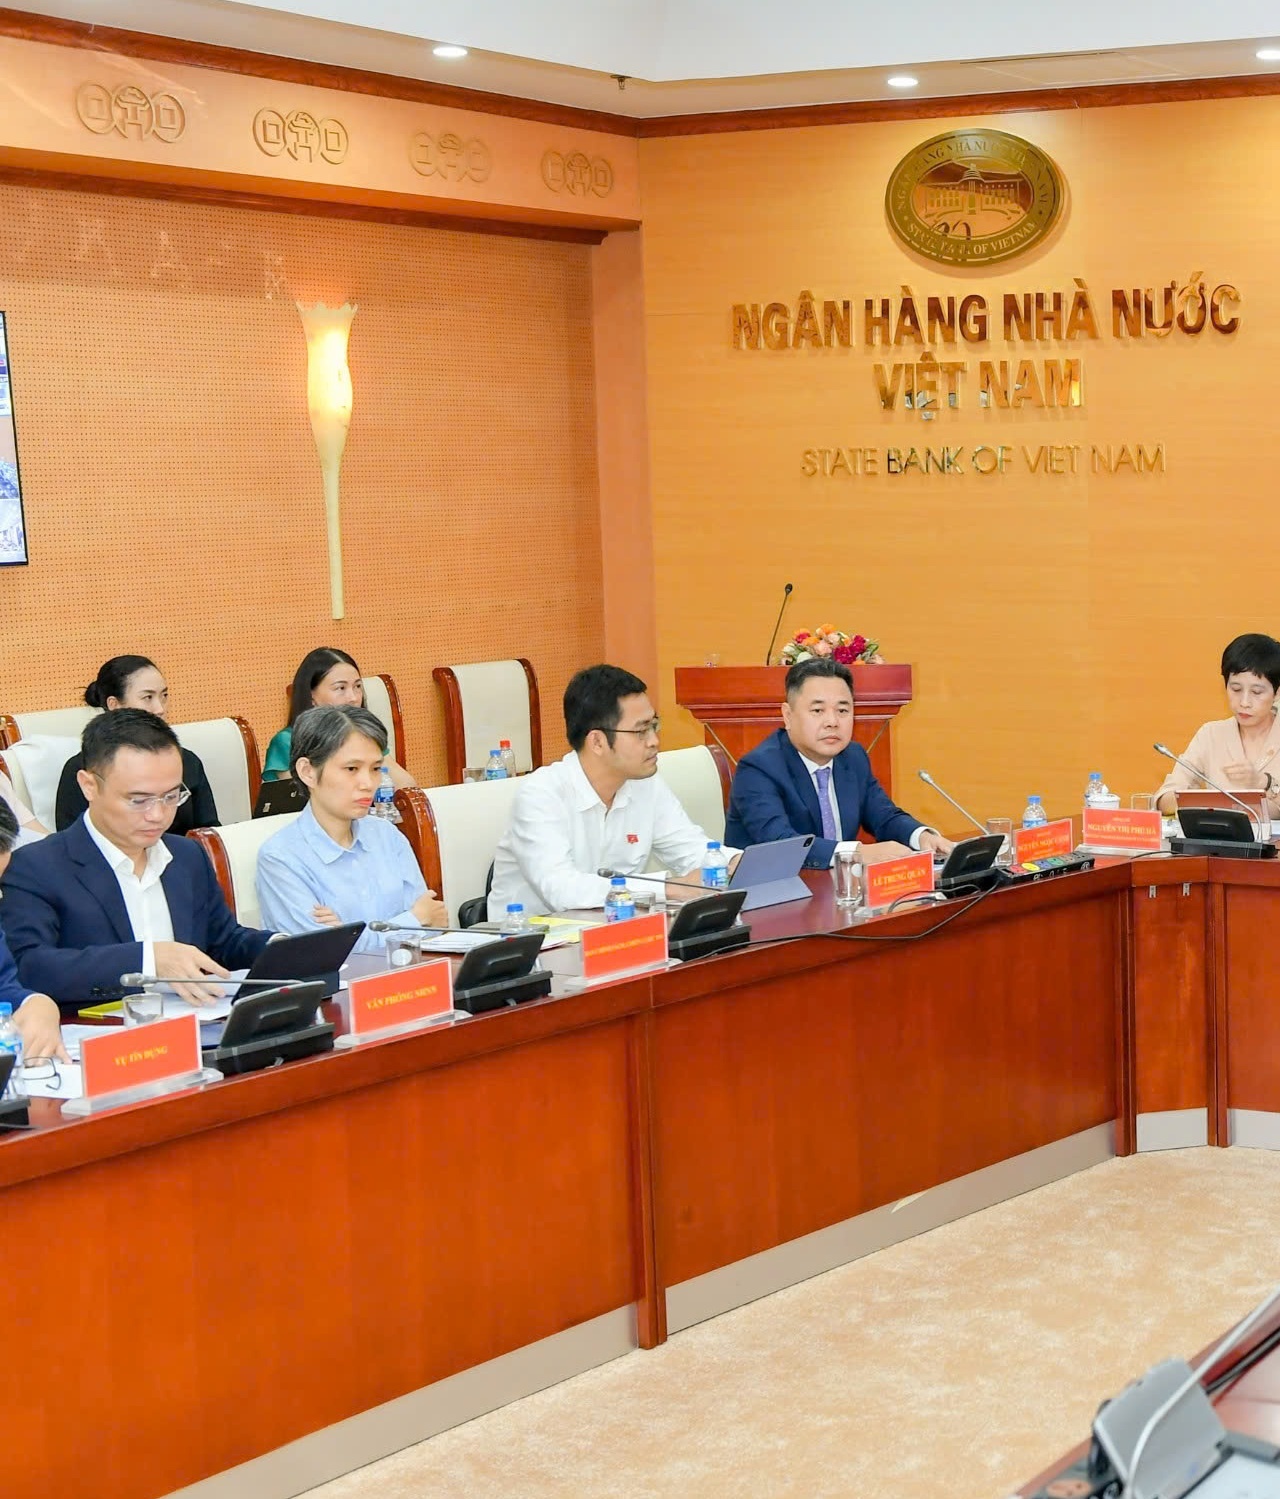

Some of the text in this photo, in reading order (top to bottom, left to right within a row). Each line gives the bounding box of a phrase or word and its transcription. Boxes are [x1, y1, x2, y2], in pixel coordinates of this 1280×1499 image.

[973, 243, 988, 255] OF
[733, 270, 1241, 350] NGÂN HÀNG NHÀ NƯỚC
[873, 351, 1083, 420] VIỆT NAM
[801, 443, 1166, 478] STATE BANK OF VIET NAM
